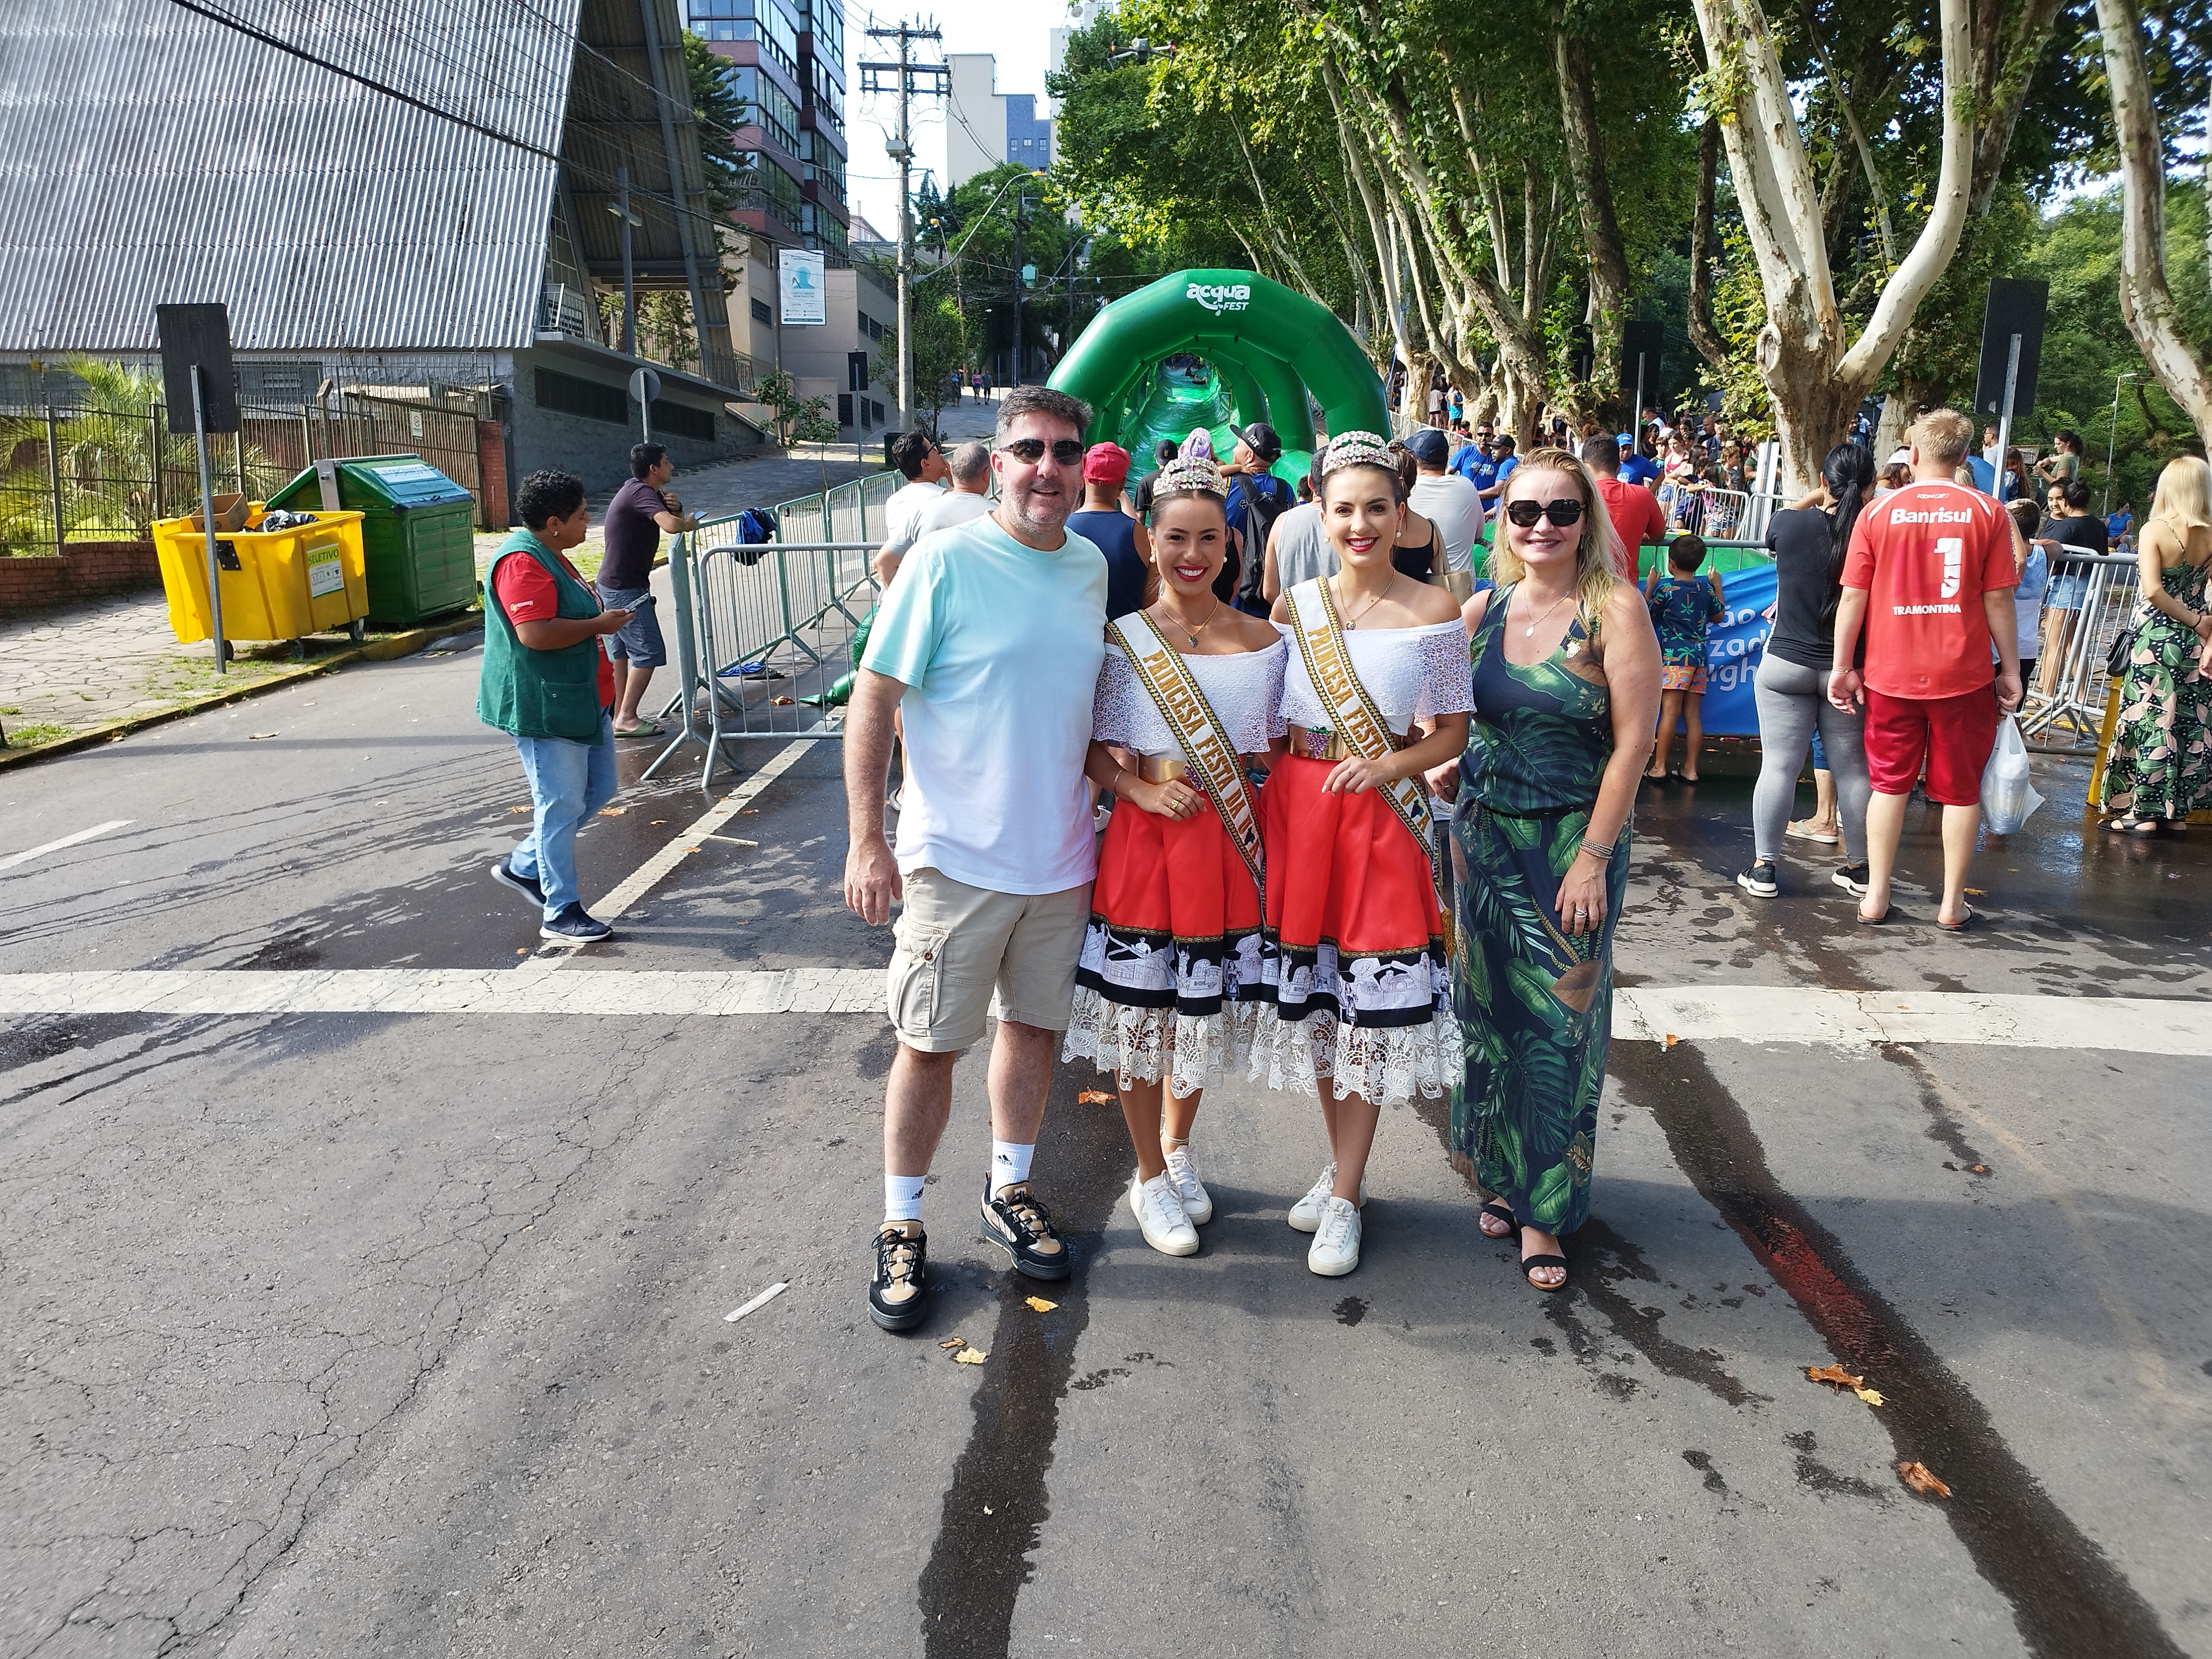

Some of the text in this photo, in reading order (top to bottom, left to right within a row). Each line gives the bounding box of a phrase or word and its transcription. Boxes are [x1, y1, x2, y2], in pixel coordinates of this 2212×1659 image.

[1187, 283, 1250, 301] acqua
[1891, 507, 1973, 525] Banrisul
[308, 549, 339, 565] SELETIVO
[1893, 603, 1961, 615] TRAMONTINA
[1704, 629, 1766, 657] zad
[1706, 657, 1757, 691] igh
[1307, 624, 1356, 708] PRINCESA
[1344, 705, 1389, 760] FESTA
[1400, 785, 1431, 833] UA
[1142, 649, 1259, 860] PRINCESA FESTA DA UA
